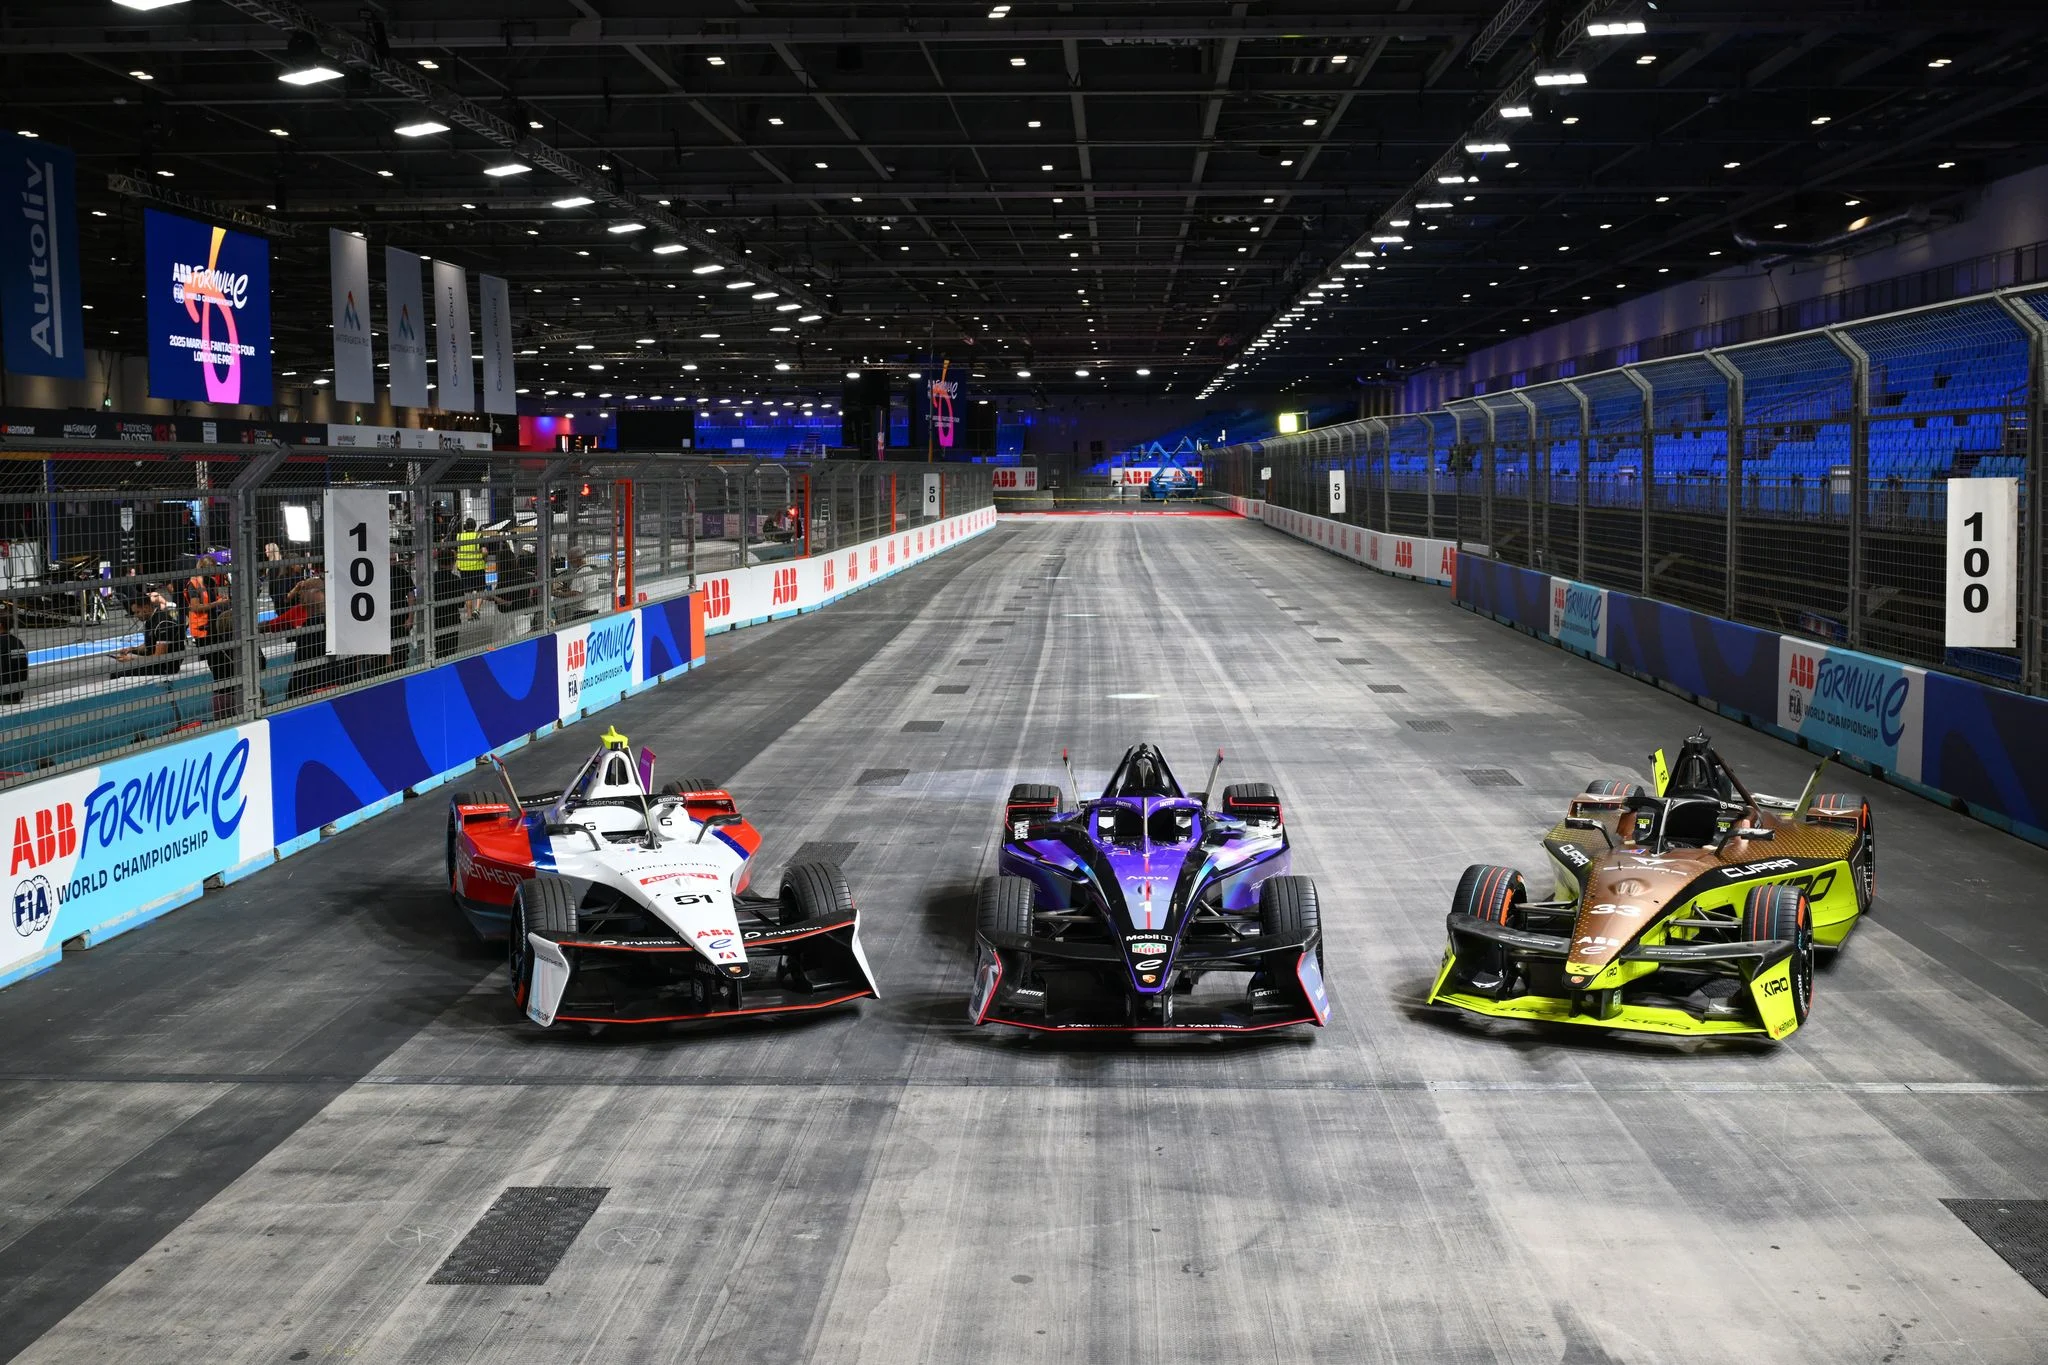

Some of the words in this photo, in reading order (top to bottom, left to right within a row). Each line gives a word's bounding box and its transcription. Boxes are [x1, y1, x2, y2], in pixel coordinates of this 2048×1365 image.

[25, 157, 53, 355] Autoliv
[173, 262, 192, 284] ABB
[169, 335, 185, 348] 2025
[186, 337, 210, 350] MARVEL
[210, 340, 240, 355] FANTASTIC
[240, 345, 255, 356] FOUR
[193, 350, 218, 363] LONDON
[993, 471, 1016, 487] ABB
[929, 486, 936, 503] 50
[1334, 483, 1341, 501] 50
[1395, 540, 1412, 569] ABB
[1963, 512, 1990, 613] 100
[349, 522, 375, 622] 100
[823, 559, 834, 593] ABB
[773, 567, 798, 605] ABB
[703, 578, 731, 619] ABB
[567, 639, 585, 672] ABB
[1789, 653, 1814, 690] ABB
[1804, 703, 1825, 722] WORLD
[1827, 713, 1879, 740] CHAMPIONSHIP
[10, 802, 77, 876] ABB
[80, 752, 213, 860] FORMULA
[1559, 844, 1590, 867] CUPRA
[57, 869, 108, 905] WORLD
[113, 830, 209, 882] CHAMPIONSHIP
[1722, 858, 1798, 878] CUPRA
[674, 895, 713, 905] 51
[1139, 901, 1152, 912] 1
[1590, 904, 1641, 917] 33
[697, 929, 735, 939] ABB
[765, 926, 822, 936] prysmian
[1577, 936, 1620, 946] ABB
[1016, 988, 1044, 997] LOCTITE
